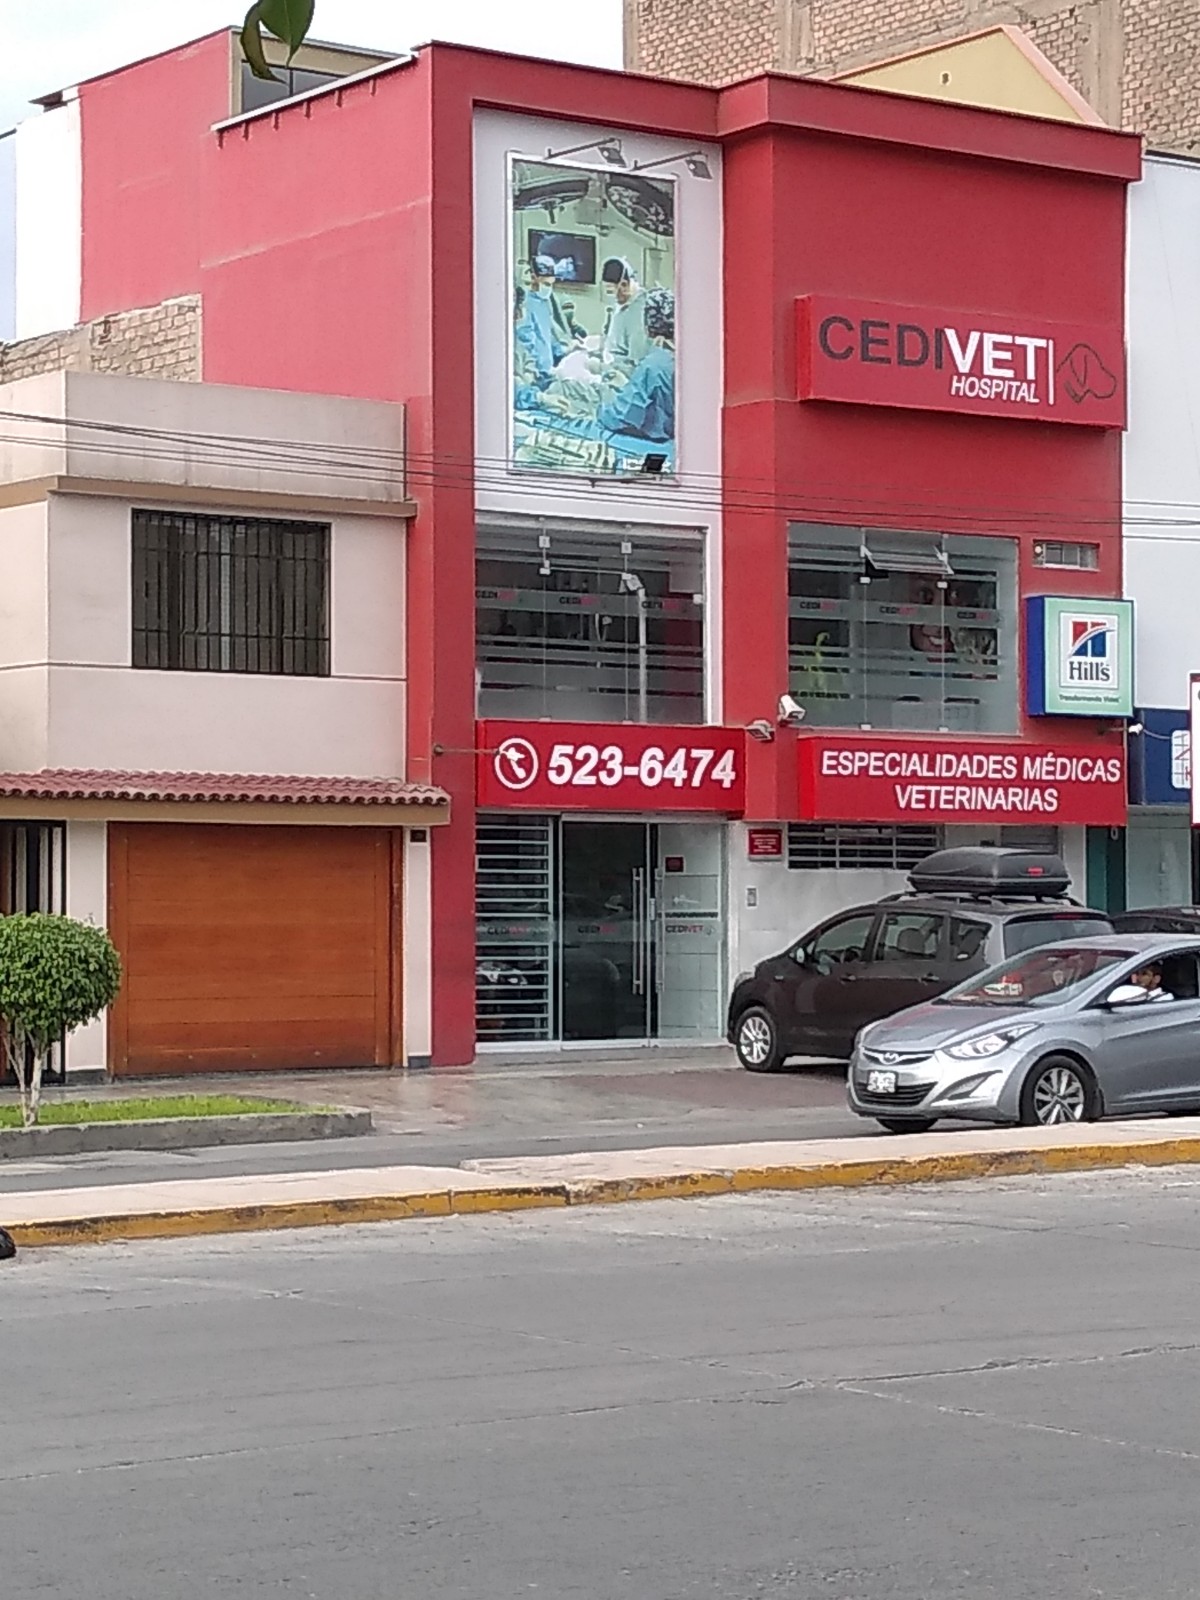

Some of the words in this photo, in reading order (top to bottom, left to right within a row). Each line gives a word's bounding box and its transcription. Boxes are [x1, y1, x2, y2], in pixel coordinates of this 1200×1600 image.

[818, 315, 1047, 381] CEDIVET
[951, 375, 1040, 404] HOSPITAL
[1068, 660, 1111, 682] Hill's
[547, 744, 736, 788] 523-6474
[821, 750, 1018, 780] ESPECIALIDADES
[1022, 752, 1121, 782] MÉDICAS
[895, 784, 1059, 812] VETERINARIAS
